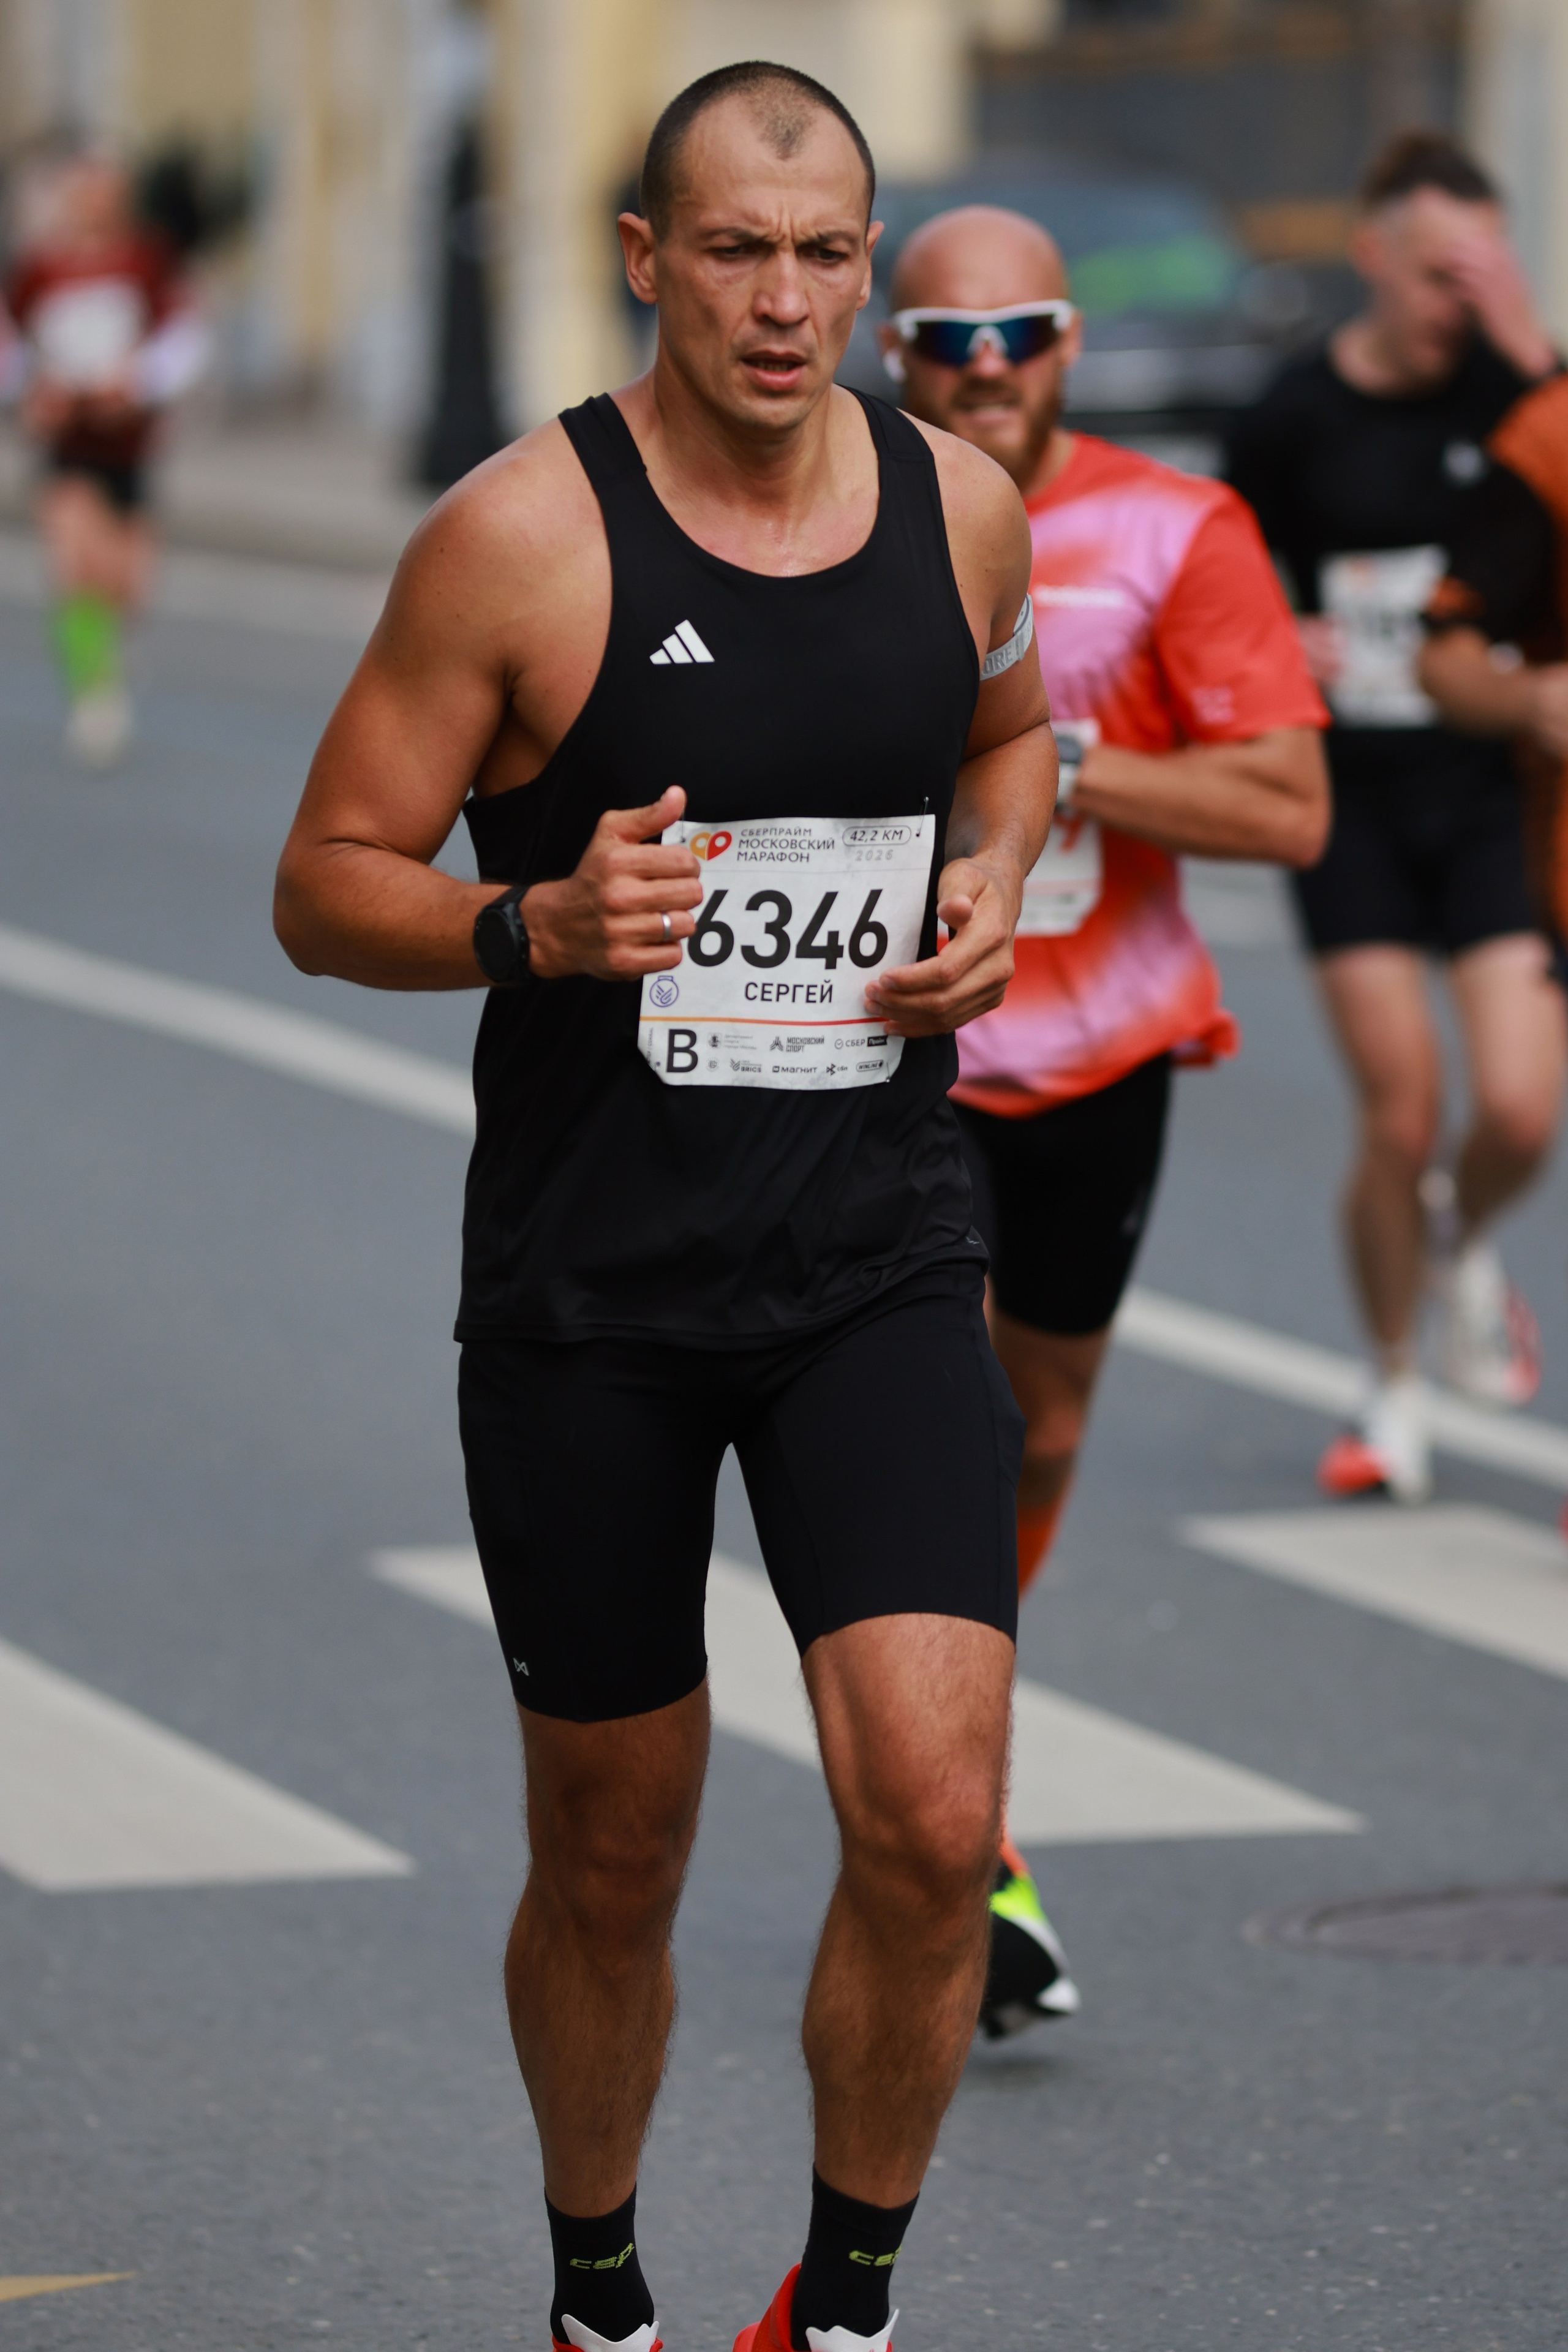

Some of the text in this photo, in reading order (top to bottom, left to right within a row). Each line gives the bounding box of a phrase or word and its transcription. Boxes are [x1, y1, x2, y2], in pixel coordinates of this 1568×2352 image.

[741, 826, 812, 837] СБЕРПРАЙМ
[850, 829, 878, 842] 42,2
[738, 837, 835, 850] МОСКОВСКИЙ
[736, 851, 810, 862] МАРАФОН
[687, 888, 889, 970] 6346
[744, 978, 834, 1004] СЕРГЕЙ
[786, 1036, 824, 1044] МОСКОВСКИЙ
[845, 1038, 865, 1047] СБЕР
[666, 1028, 698, 1073] B
